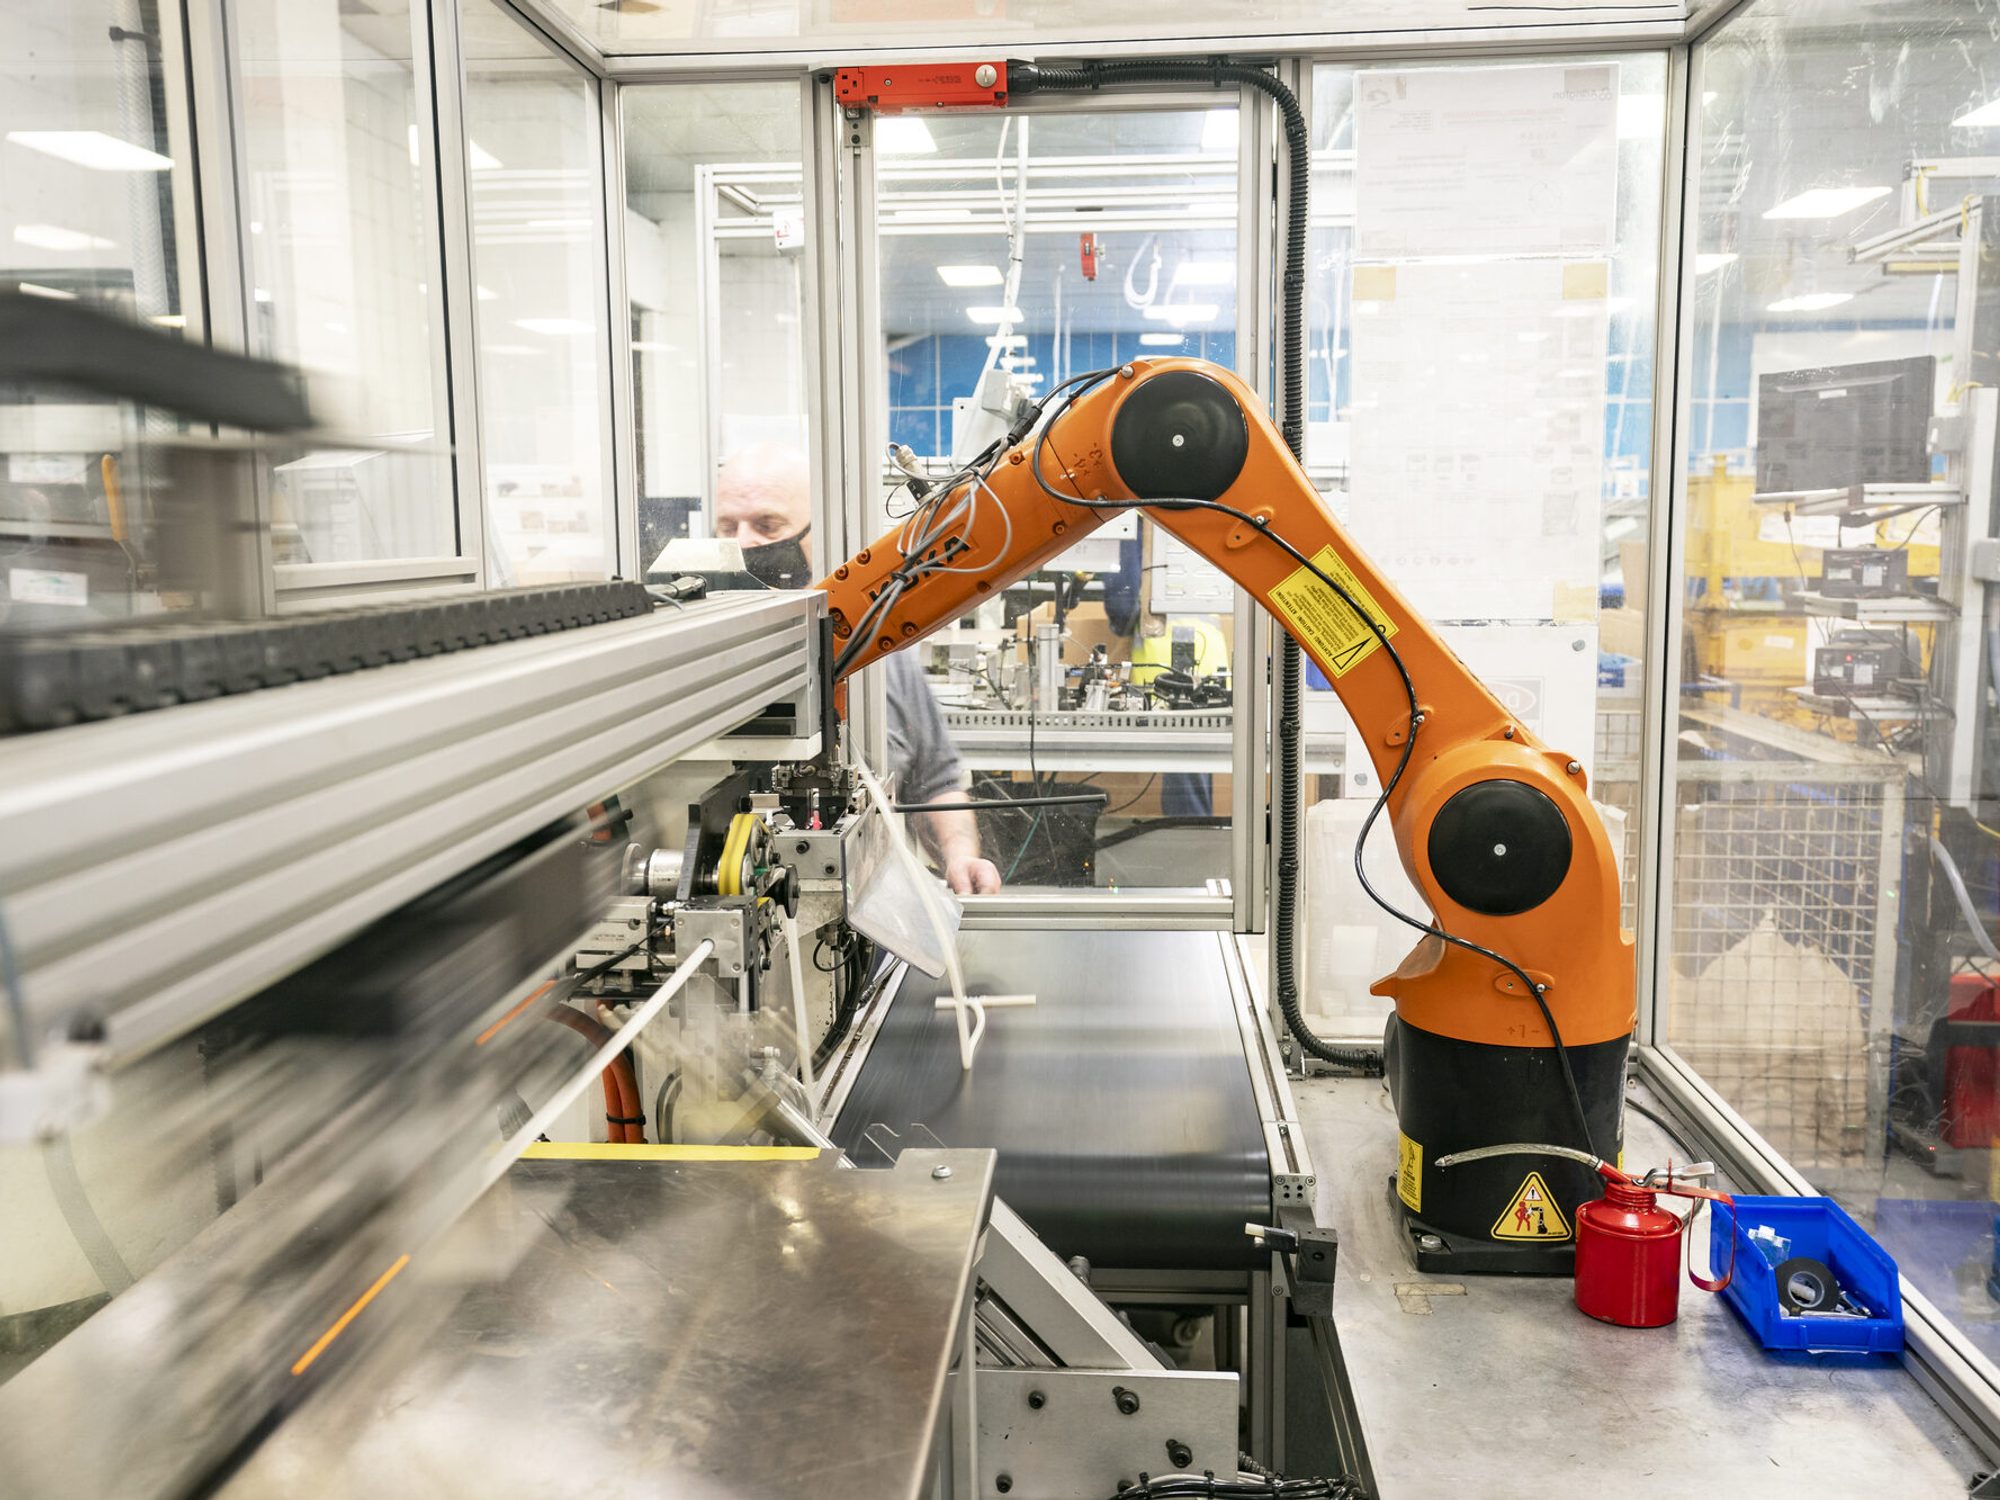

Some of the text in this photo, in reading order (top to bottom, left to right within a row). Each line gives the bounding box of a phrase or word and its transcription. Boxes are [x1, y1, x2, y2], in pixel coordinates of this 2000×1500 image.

[1275, 590, 1297, 615] ATTENTION!
[1297, 615, 1314, 635] CAUTION!
[1314, 635, 1332, 657] ACHTUNG!
